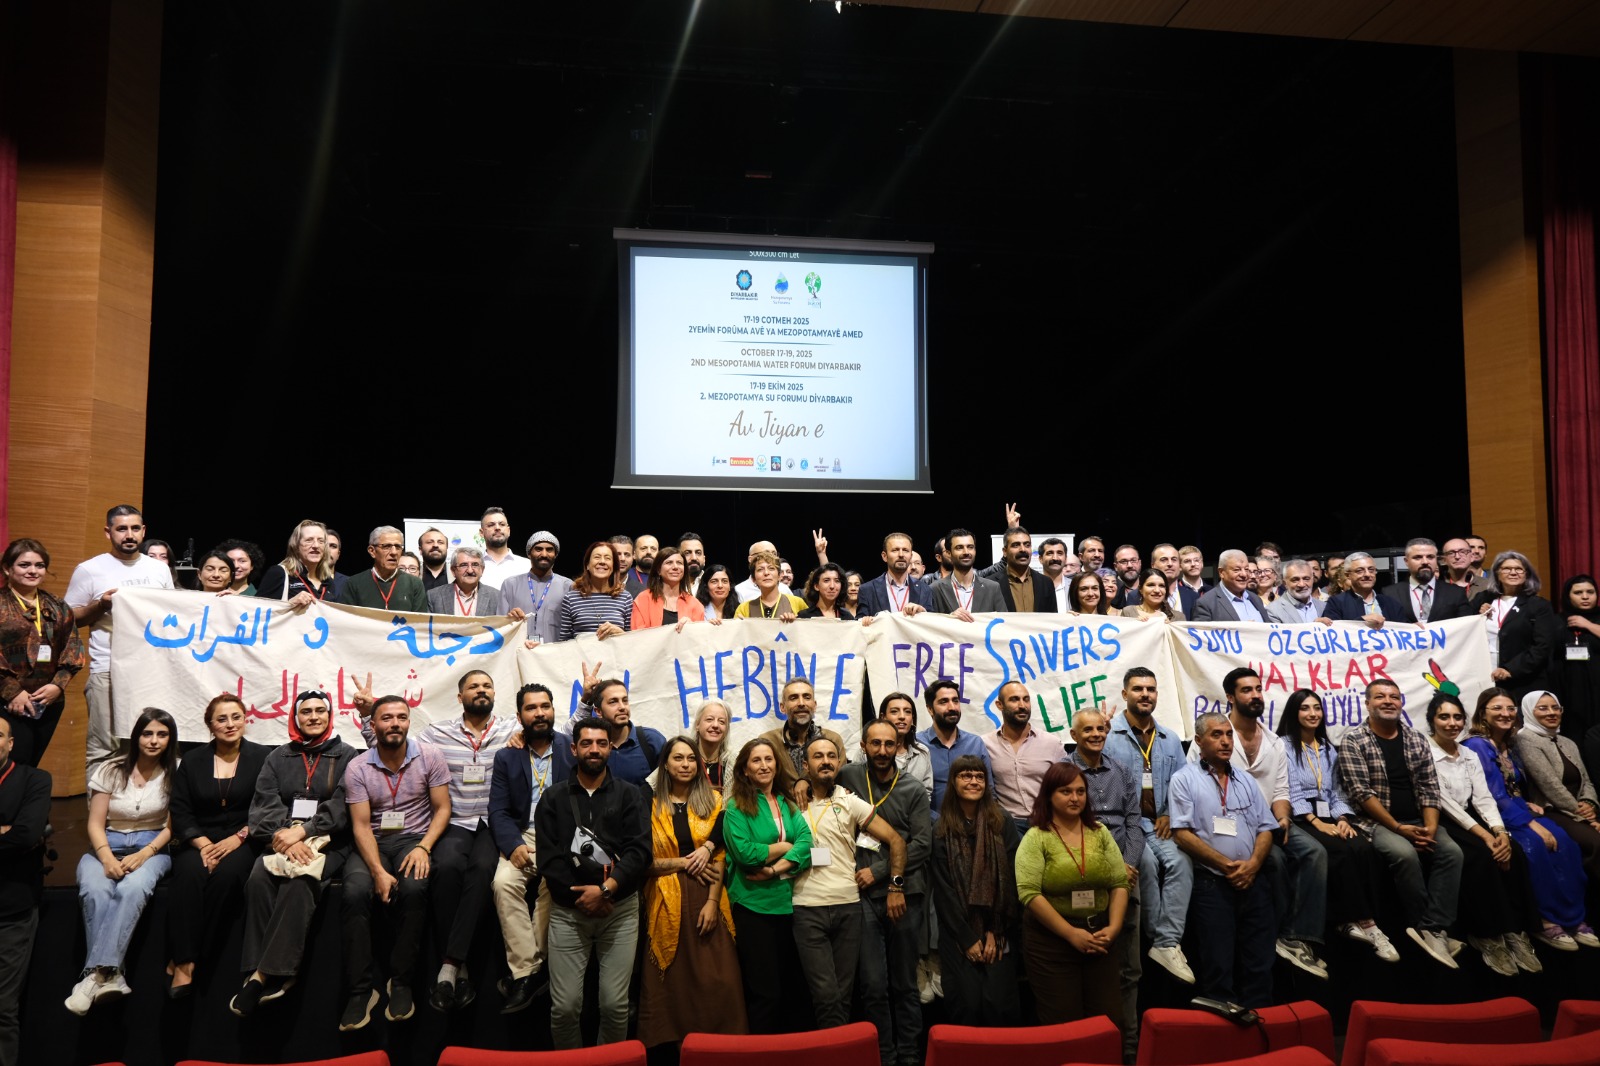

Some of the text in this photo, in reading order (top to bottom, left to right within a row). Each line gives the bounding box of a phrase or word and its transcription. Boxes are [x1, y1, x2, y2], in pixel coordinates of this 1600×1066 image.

[743, 315, 810, 325] 17-19 COTMEH 2025
[766, 327, 776, 336] YA
[842, 330, 864, 339] AMED
[741, 348, 813, 358] OCTOBER 17-19, 2025
[690, 358, 862, 371] 2ND MESOPOTAMIA WATER FORUM DIYARBAKIR
[750, 381, 766, 390] 17-19
[787, 383, 804, 391] 2025
[700, 392, 707, 400] 2.
[708, 392, 764, 402] MEZOPOTAMYA
[765, 393, 775, 402] SU
[776, 394, 808, 403] FORUMU
[729, 409, 825, 445] Av Jiyan e
[730, 457, 754, 466] tmmob
[144, 605, 272, 663] الفرات
[1189, 627, 1243, 655] SUYU
[892, 622, 1122, 705] FREE RIVERS
